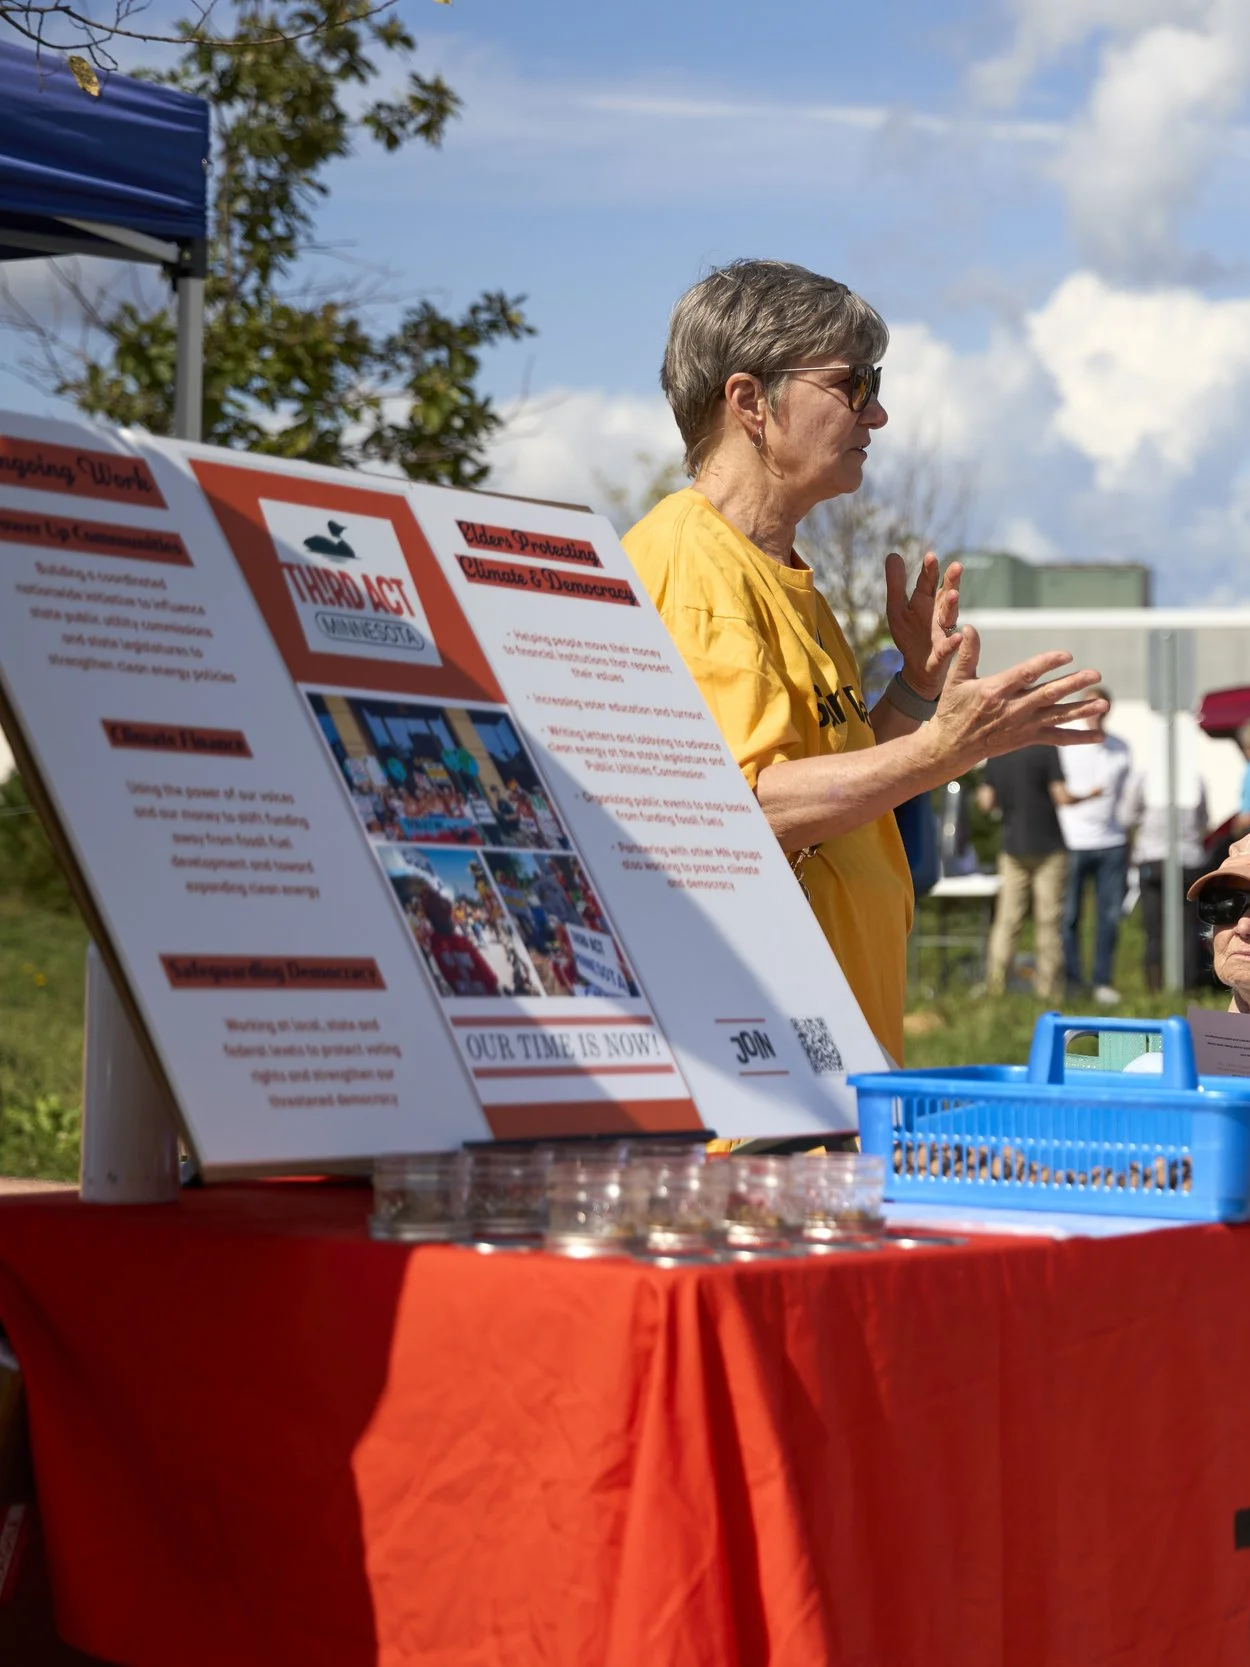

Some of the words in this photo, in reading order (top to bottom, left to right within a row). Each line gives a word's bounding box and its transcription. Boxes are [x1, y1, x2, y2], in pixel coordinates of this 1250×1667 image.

[76, 453, 152, 493] Work
[457, 520, 512, 549] Elders
[511, 530, 600, 567] Protecting
[361, 573, 415, 617] ACT
[460, 555, 527, 586] Climate
[530, 569, 541, 588] &
[541, 568, 636, 606] Democracy
[322, 617, 418, 644] MINNESOTA
[466, 1033, 513, 1061] OUR
[517, 1032, 574, 1060] TIME
[579, 1032, 600, 1059] IS
[604, 1032, 660, 1059] NOW!
[731, 1029, 776, 1065] JOIN
